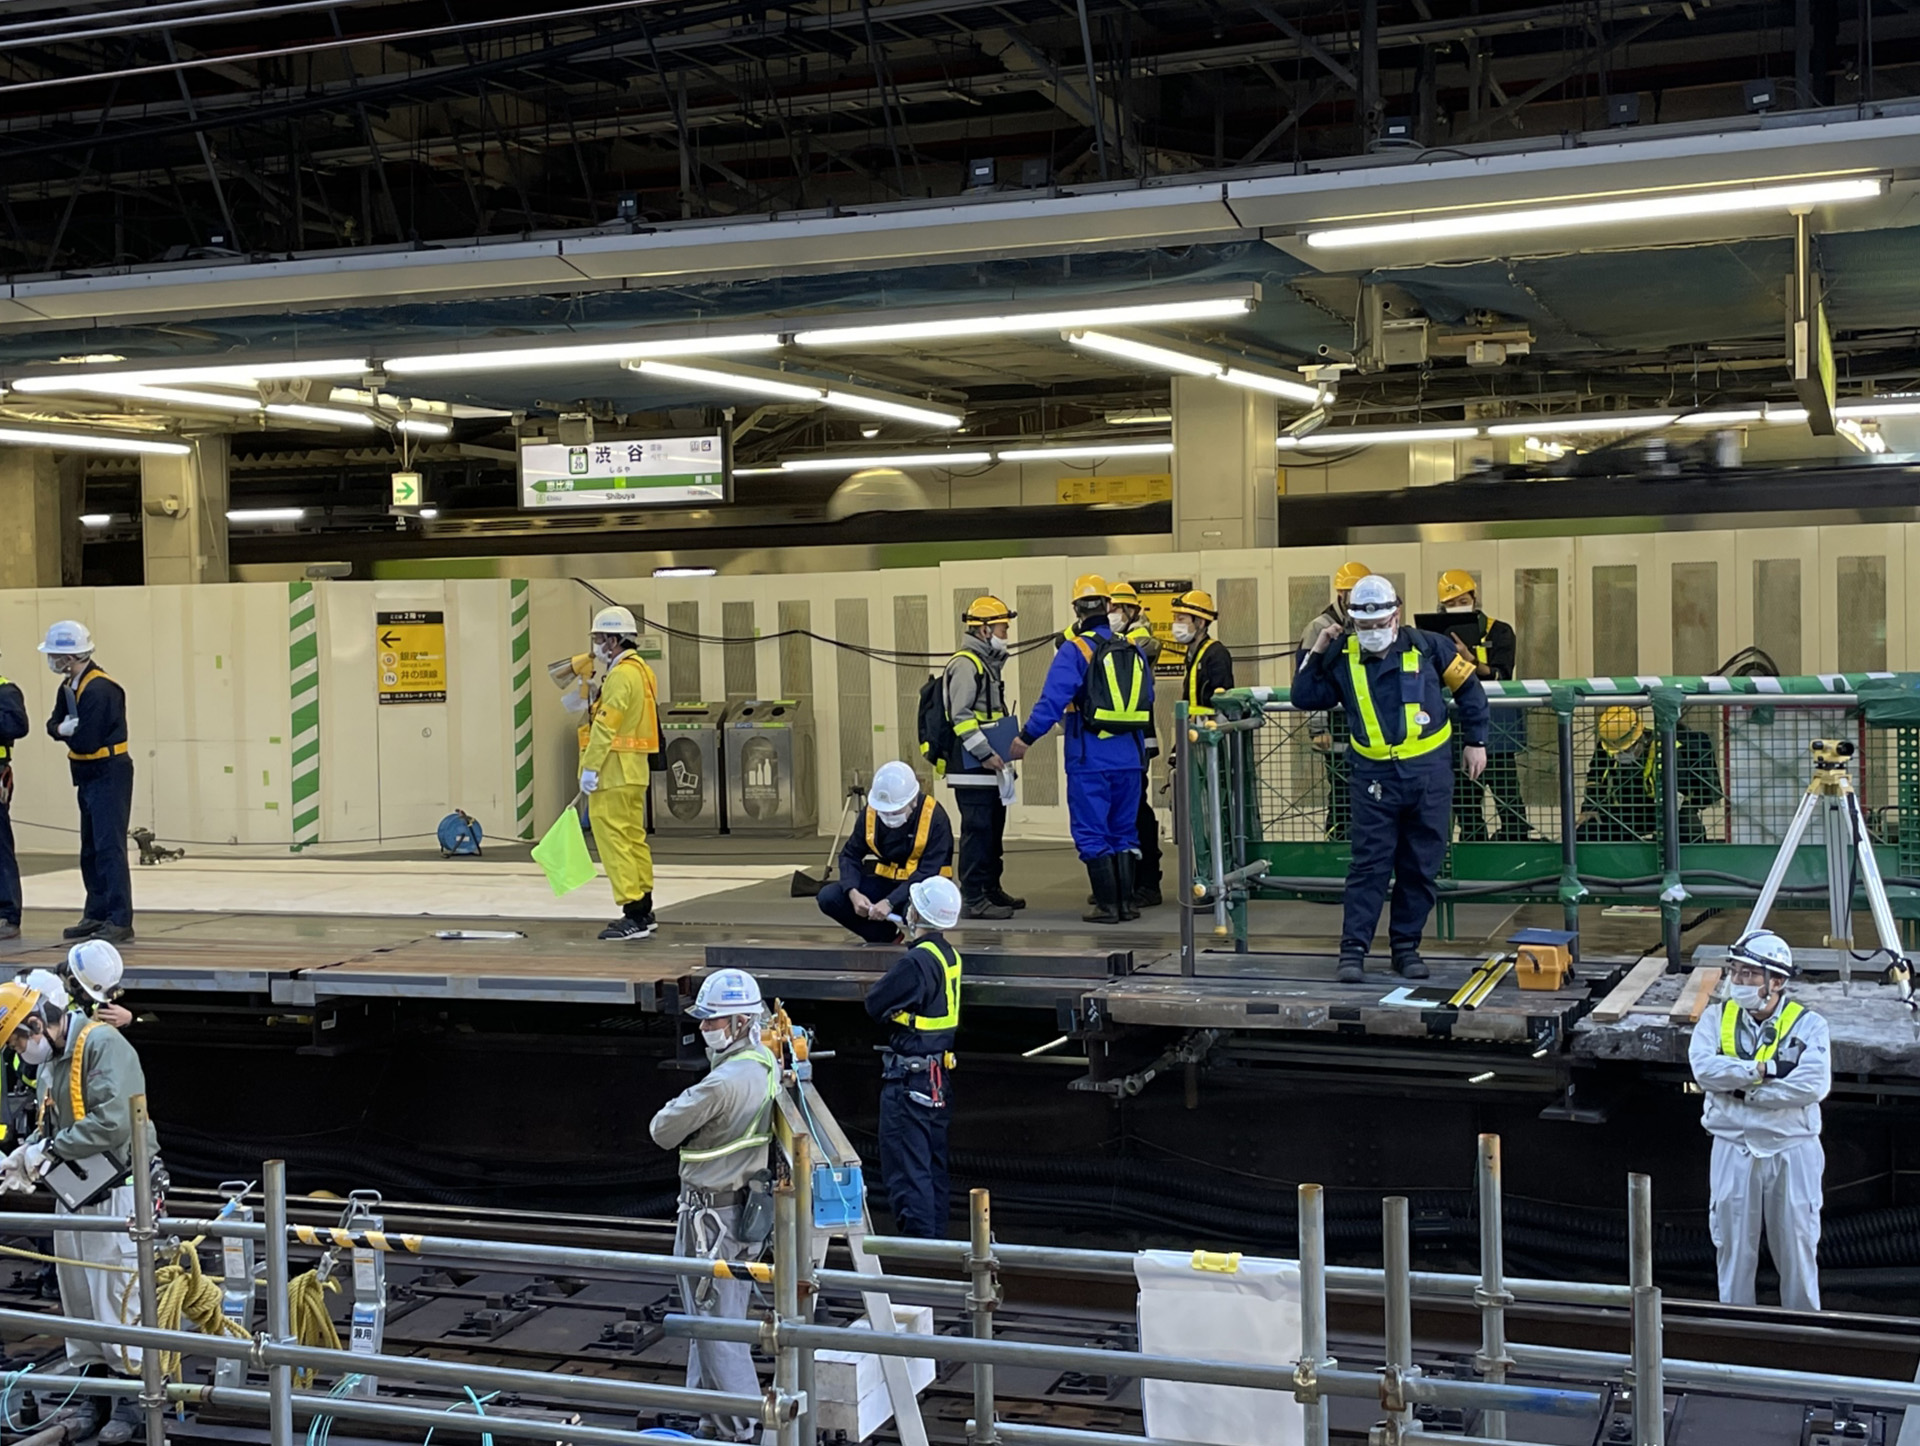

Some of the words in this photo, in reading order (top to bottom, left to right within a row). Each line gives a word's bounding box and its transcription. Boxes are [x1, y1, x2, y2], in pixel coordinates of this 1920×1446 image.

[595, 444, 643, 463] 渋谷
[574, 461, 584, 470] 20
[606, 493, 635, 501] Shibuya
[353, 1327, 372, 1340] 兼用
